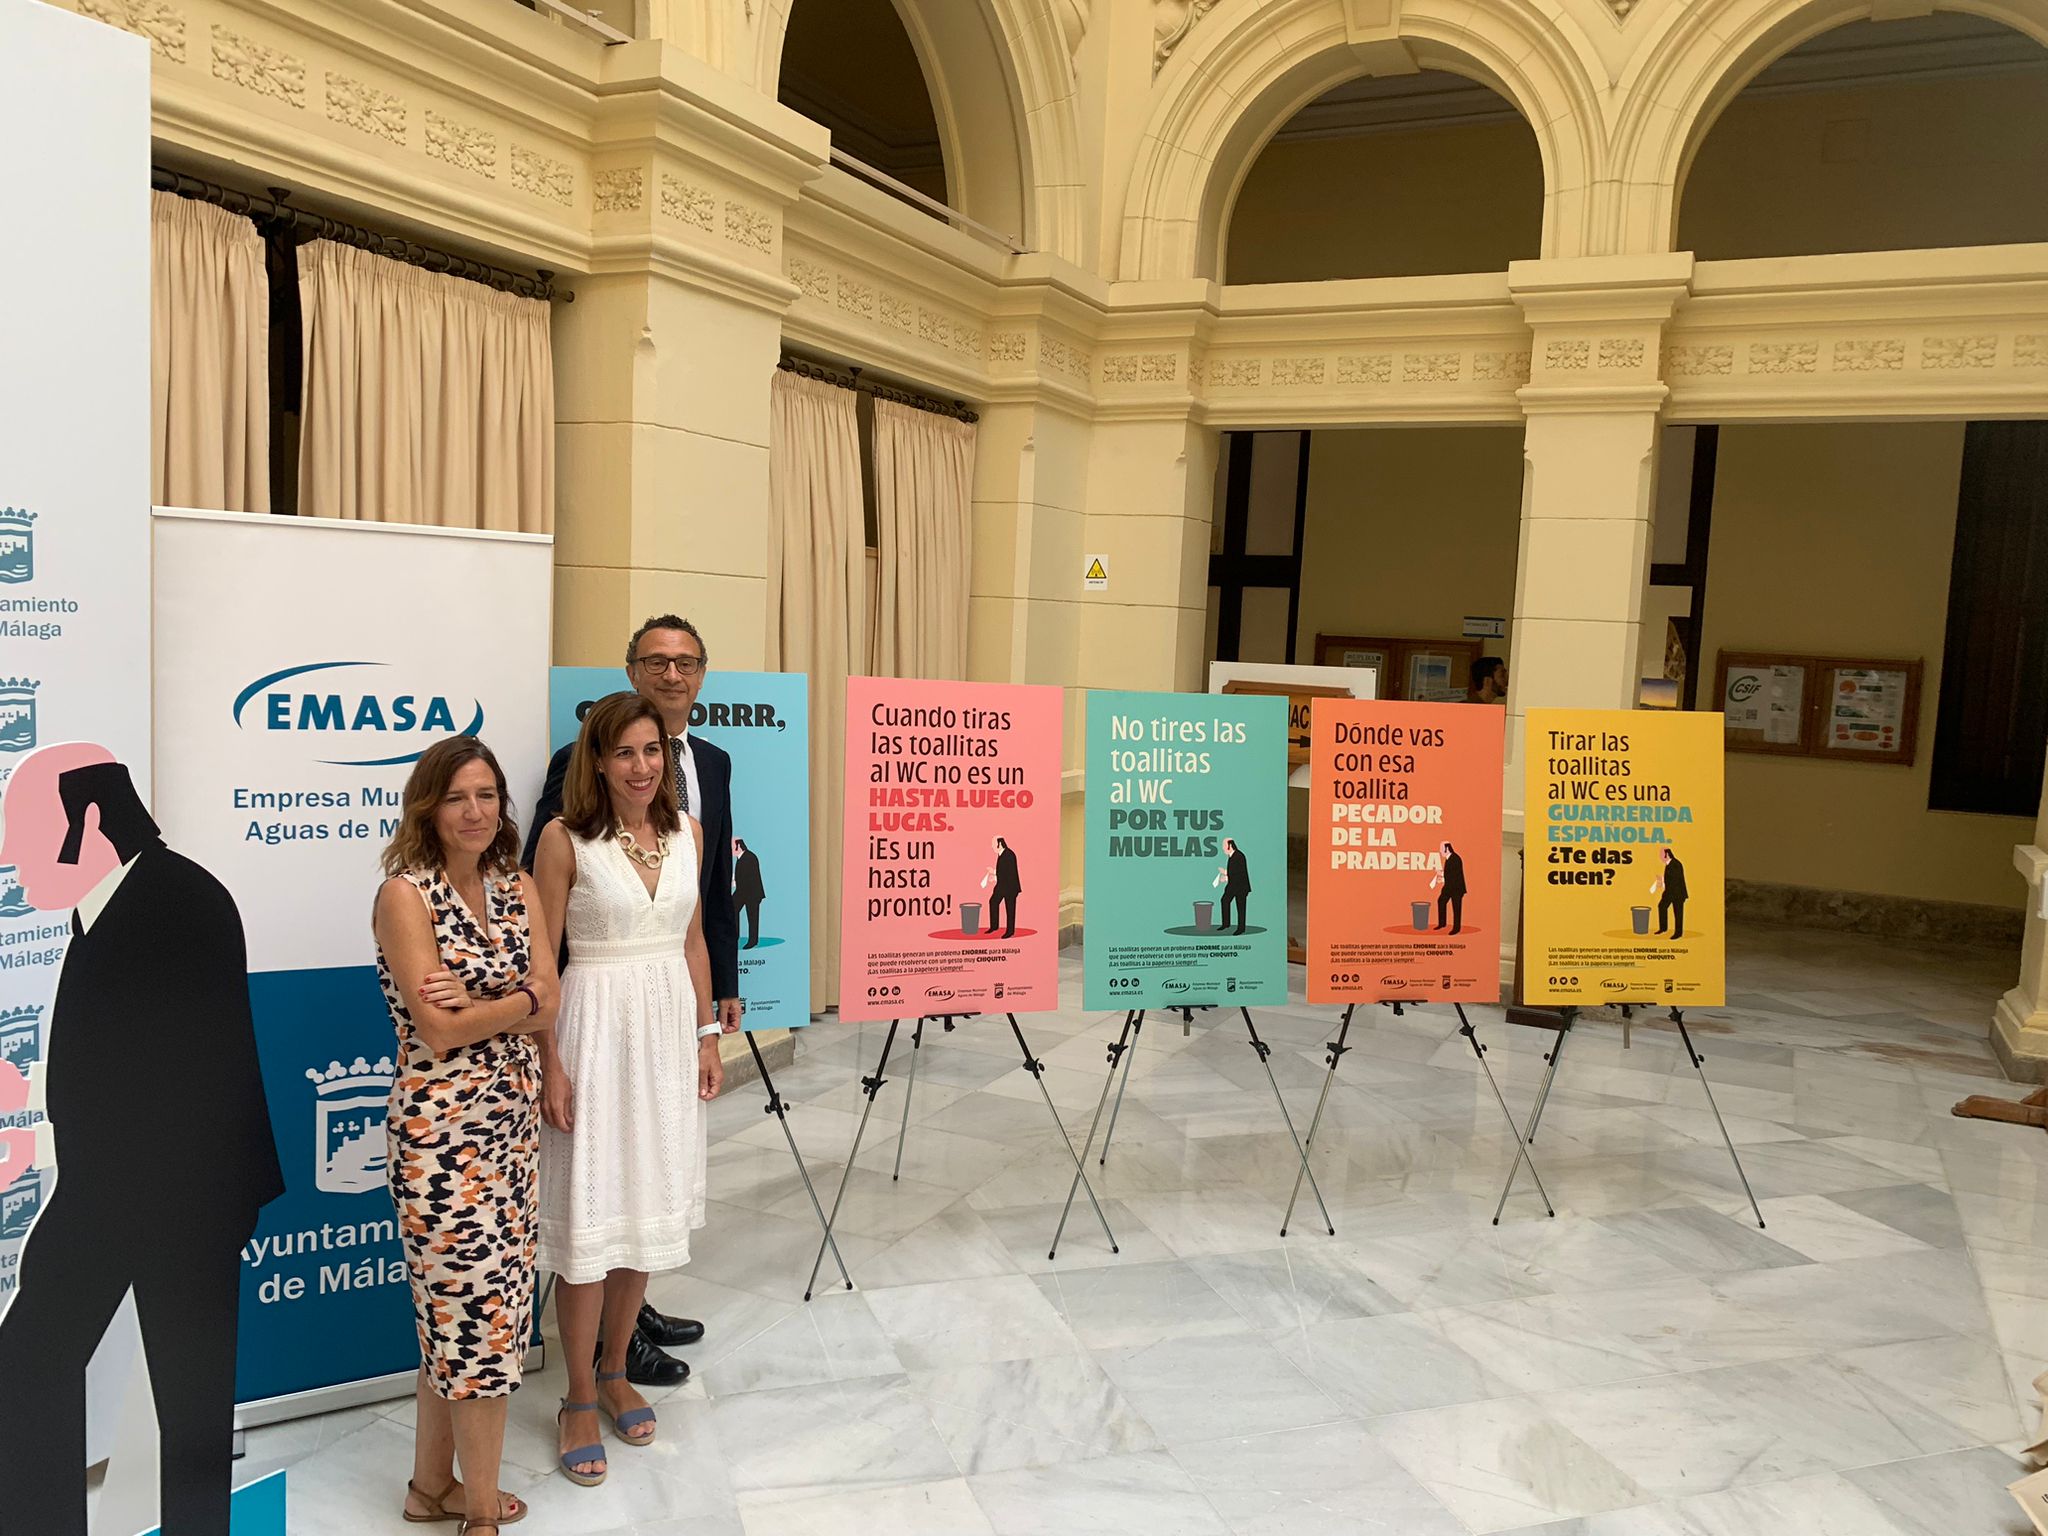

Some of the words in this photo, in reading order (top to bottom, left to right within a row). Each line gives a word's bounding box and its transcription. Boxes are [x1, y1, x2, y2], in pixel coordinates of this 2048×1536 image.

[0, 597, 78, 613] amiento
[1735, 684, 1762, 694] CSIF
[267, 693, 456, 732] EMASA
[872, 703, 956, 728] Cuando
[963, 708, 1011, 730] tiras
[1111, 715, 1144, 741] No
[1151, 717, 1207, 743] tires
[1214, 719, 1247, 744] las
[1335, 722, 1403, 746] Dónde
[1409, 728, 1444, 747] vas
[871, 732, 903, 755] las
[909, 735, 998, 757] toallitas
[1548, 731, 1596, 751] Tirar
[1602, 732, 1629, 752] las
[1110, 748, 1211, 774] toallitas
[1334, 753, 1372, 772] con
[1379, 755, 1415, 773] esa
[1548, 756, 1630, 776] toallitas
[870, 761, 889, 783] al
[897, 761, 927, 784] WC
[934, 765, 961, 784] no
[967, 765, 991, 785] es
[998, 766, 1024, 785] un
[869, 788, 950, 808] HASTA
[956, 789, 1034, 809] LUEGO
[1110, 779, 1131, 804] al
[1138, 779, 1173, 804] WC
[1334, 778, 1409, 800] toallita
[1548, 781, 1565, 800] al
[1571, 781, 1599, 800] WC
[1605, 784, 1627, 801] es
[1633, 784, 1671, 802] una
[234, 788, 350, 812] Empresa
[869, 812, 954, 832] LUCAS.
[1109, 808, 1167, 830] POR
[1173, 810, 1224, 831] TUS
[1332, 803, 1442, 824] PECADOR
[1548, 804, 1693, 823] GUARRERIDA
[246, 821, 329, 845] Aguas
[338, 819, 369, 838] de
[1331, 827, 1362, 846] DE
[1367, 828, 1397, 846] LA
[1548, 823, 1673, 844] ESPAÑOLA.
[907, 839, 934, 860] un
[1109, 836, 1218, 857] MUELAS
[1547, 846, 1586, 864] ¿Te
[1591, 848, 1633, 864] das
[1331, 851, 1443, 870] PRADERA
[868, 867, 930, 889] hasta
[1547, 868, 1615, 885] cuen?
[868, 894, 952, 921] pronto!
[0, 922, 70, 946] tamient
[879, 960, 897, 968] puede
[934, 950, 960, 958] problema
[914, 966, 938, 974] papelera
[939, 965, 963, 973] siempre!
[0, 1110, 44, 1129] Mála
[240, 1219, 402, 1267] yuntam
[258, 1273, 305, 1304] de
[320, 1257, 409, 1294] Mála
